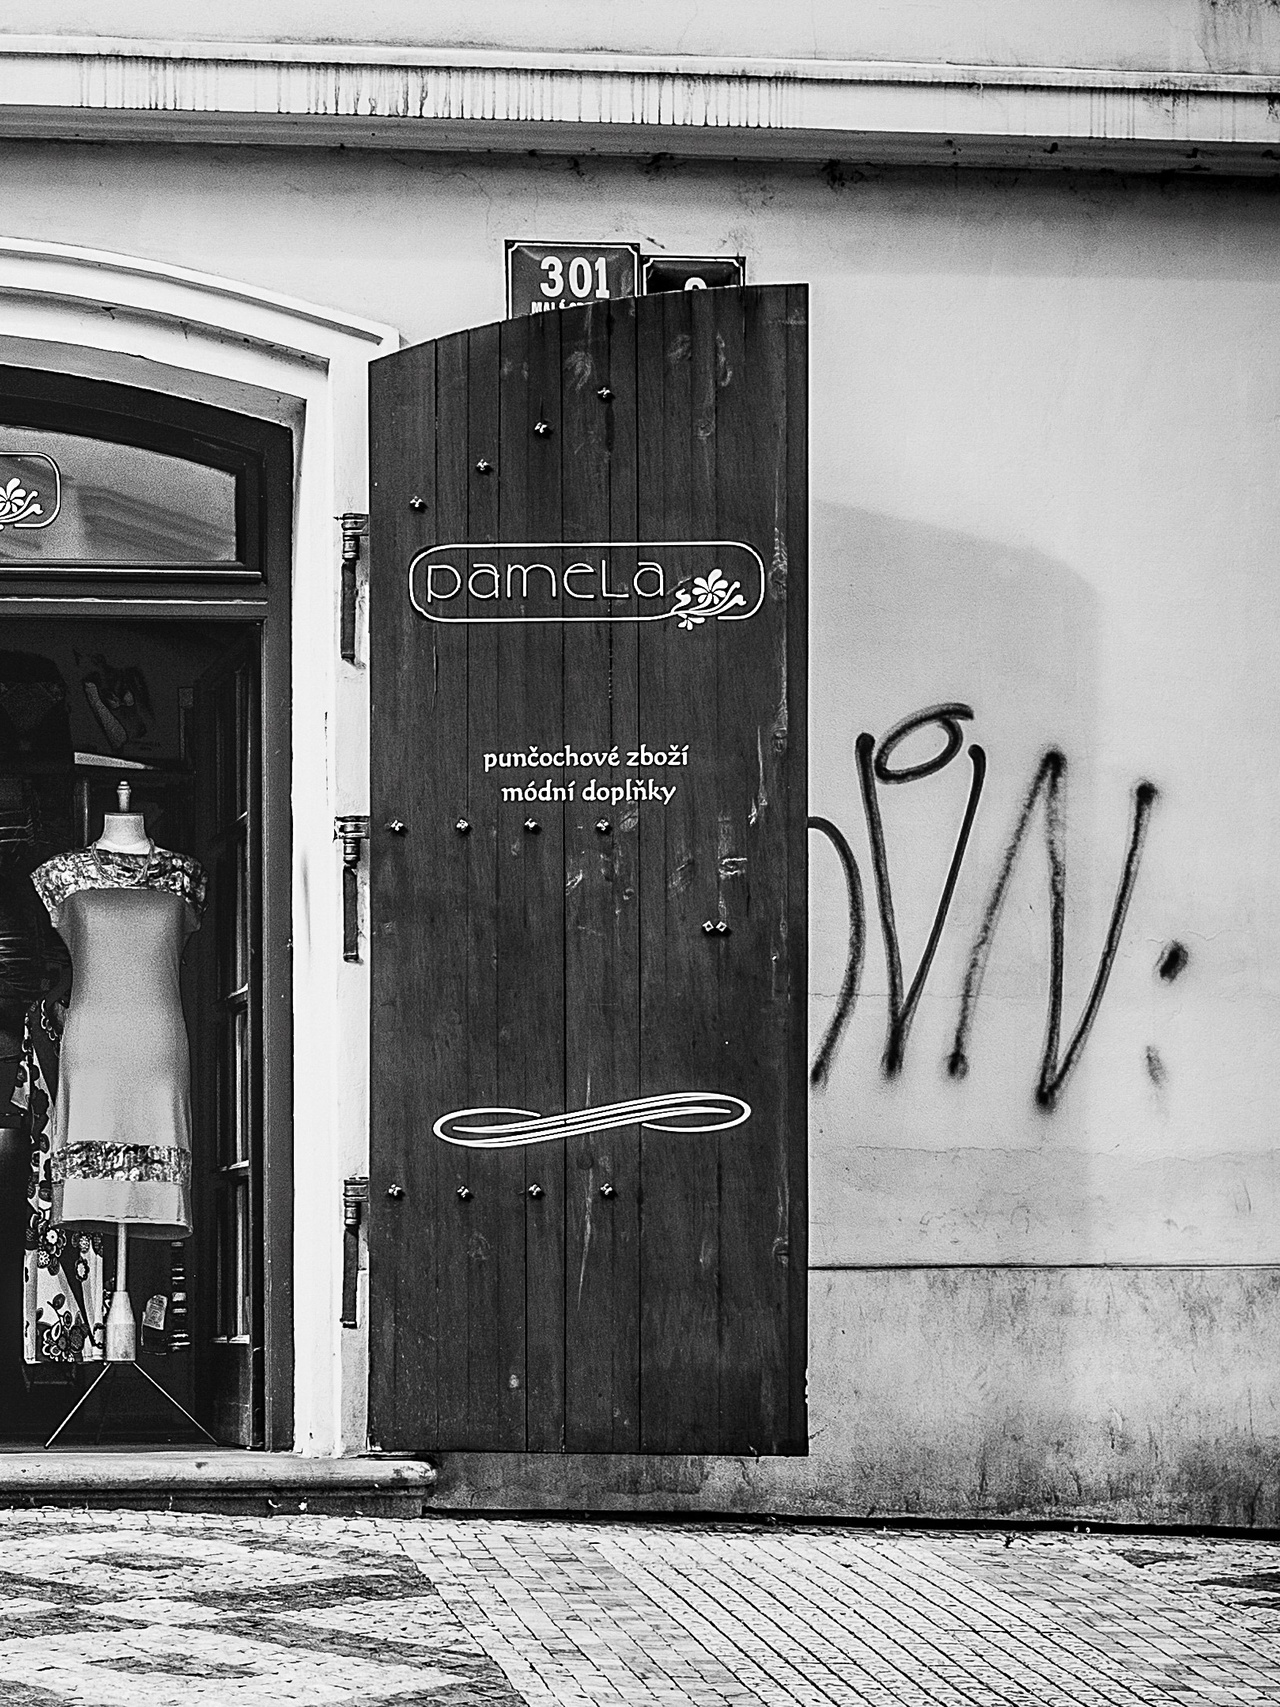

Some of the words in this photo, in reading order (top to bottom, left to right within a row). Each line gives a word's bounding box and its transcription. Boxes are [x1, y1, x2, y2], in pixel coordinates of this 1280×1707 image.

[540, 255, 610, 299] 301
[483, 744, 621, 773] punčochové
[626, 743, 690, 768] zboží
[501, 778, 576, 803] módní
[582, 777, 677, 806] doplňky
